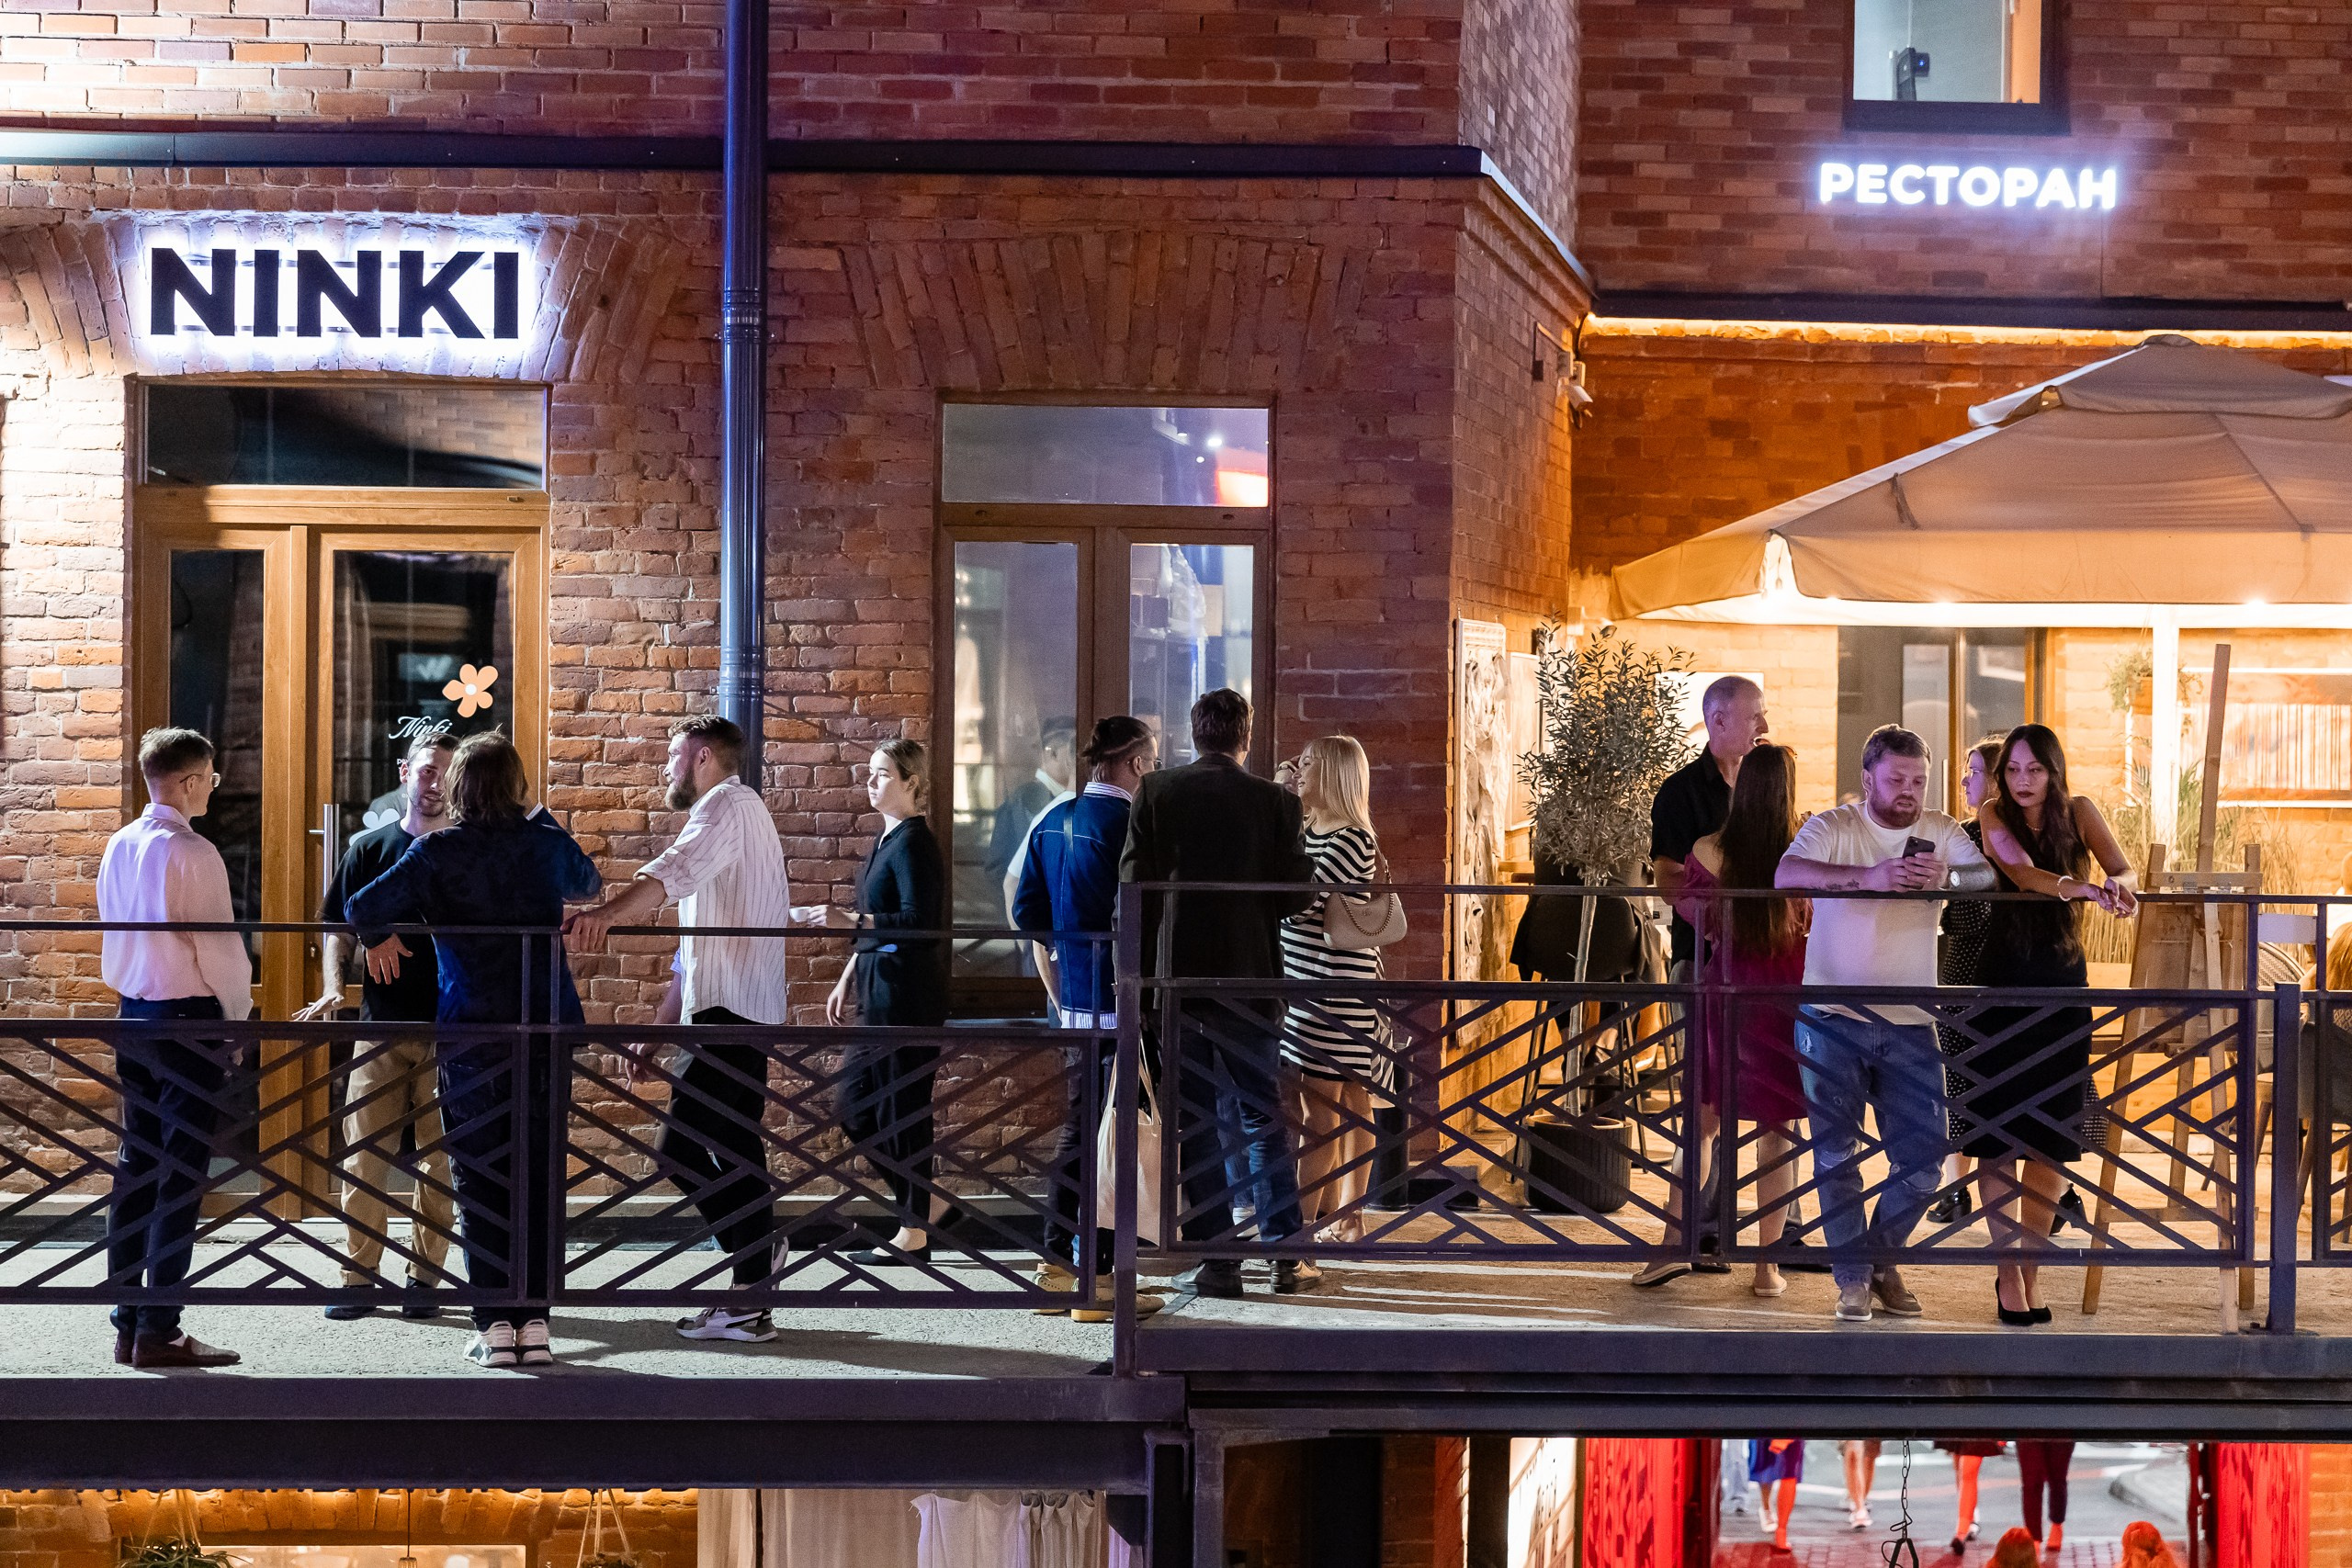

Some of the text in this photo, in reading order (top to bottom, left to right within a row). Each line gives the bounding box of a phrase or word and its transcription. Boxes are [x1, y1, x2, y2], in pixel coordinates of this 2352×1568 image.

[1819, 162, 2117, 209] РЕСТОРАН
[150, 247, 519, 339] NINKI
[388, 716, 453, 739] Ninki
